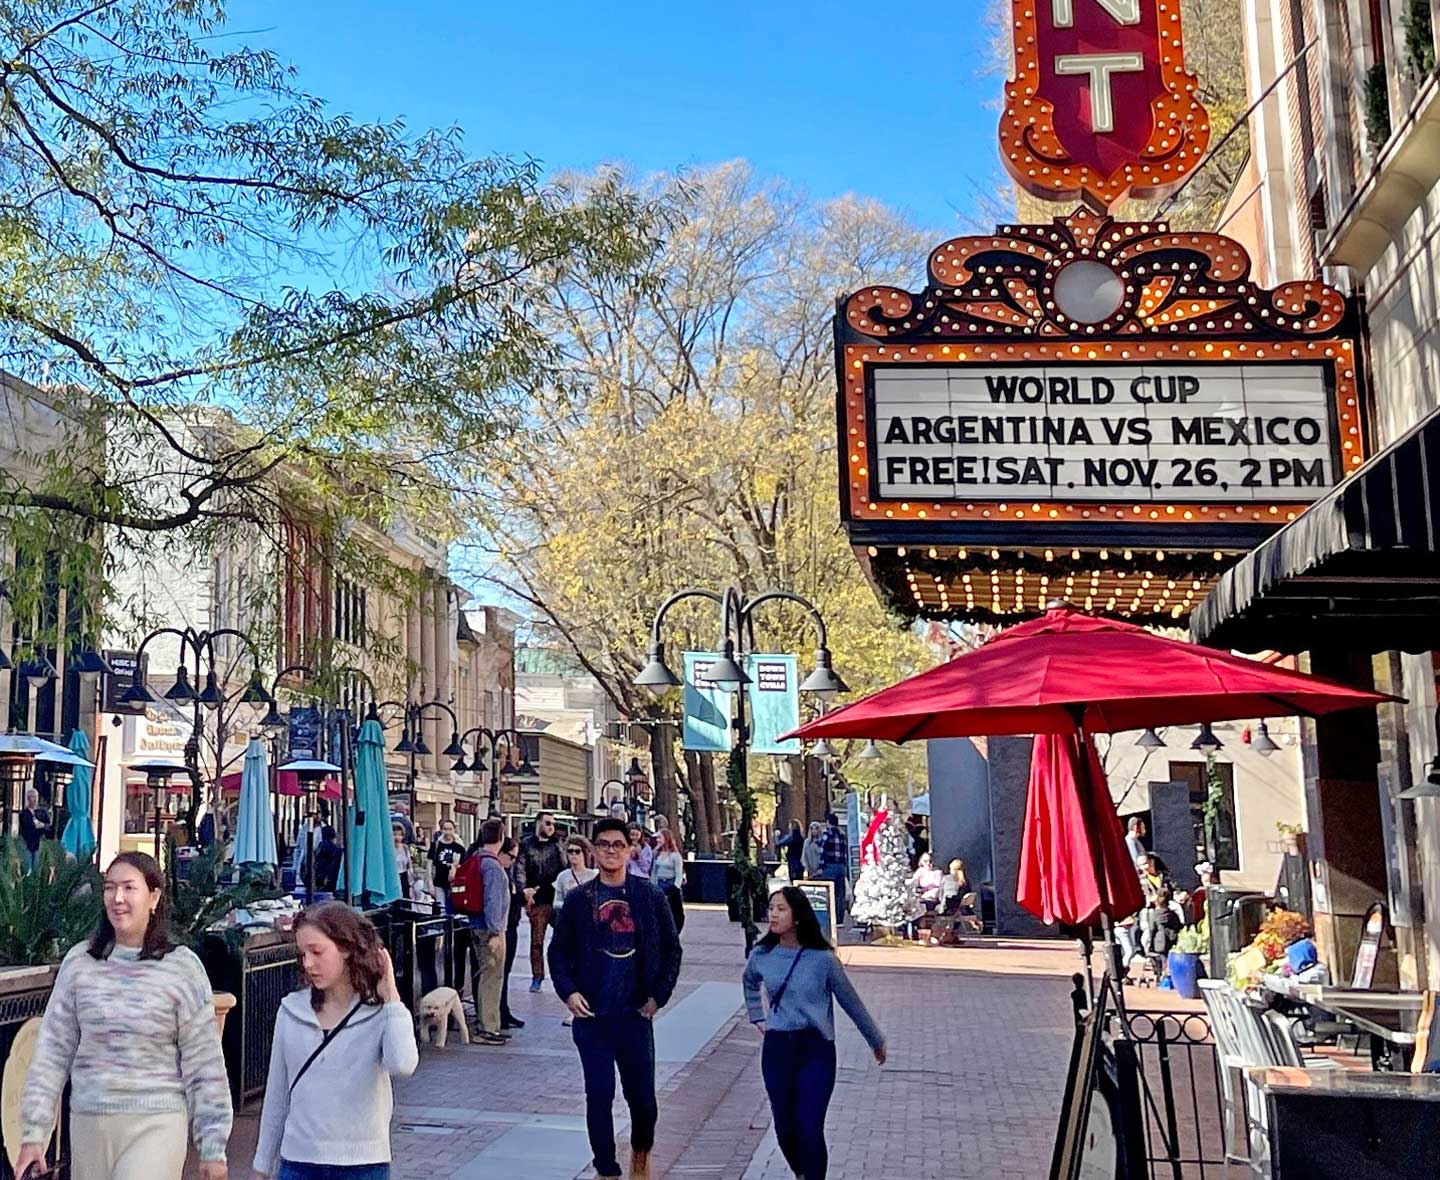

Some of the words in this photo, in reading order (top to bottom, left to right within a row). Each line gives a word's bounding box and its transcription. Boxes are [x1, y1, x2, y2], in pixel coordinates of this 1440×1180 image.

[985, 376, 1115, 404] WORLD
[1130, 376, 1200, 403] CUP
[884, 416, 1094, 445] ARGENTINA
[1101, 417, 1152, 445] VS
[1171, 416, 1321, 446] MEXICO
[1084, 458, 1162, 490] NOV.
[1171, 458, 1228, 492] 26,
[759, 673, 786, 681] TOWN
